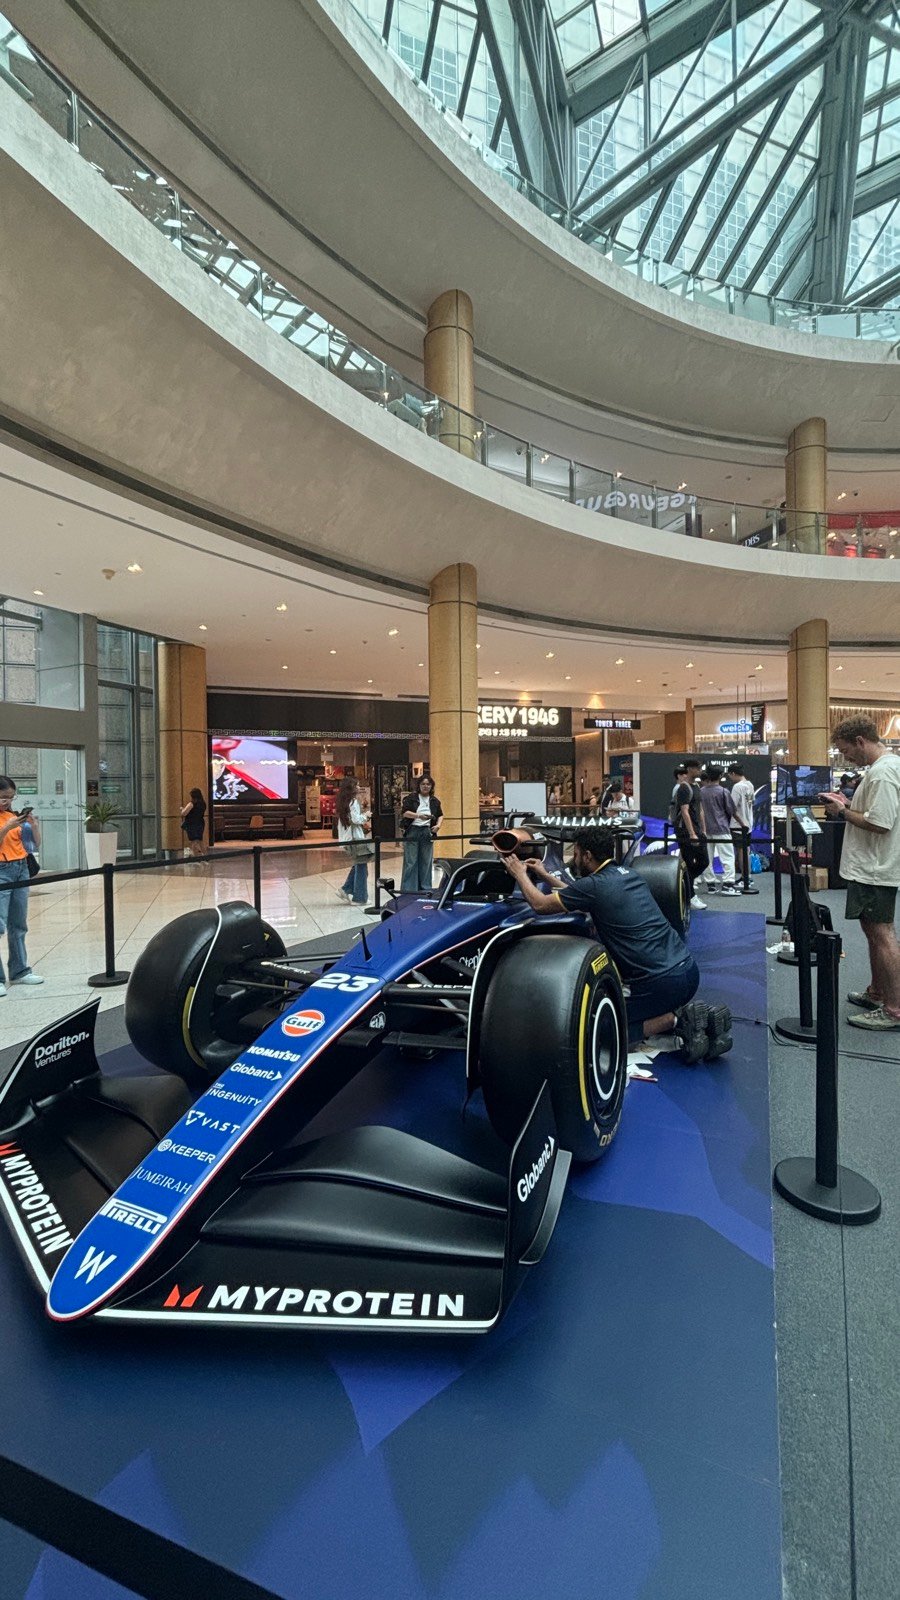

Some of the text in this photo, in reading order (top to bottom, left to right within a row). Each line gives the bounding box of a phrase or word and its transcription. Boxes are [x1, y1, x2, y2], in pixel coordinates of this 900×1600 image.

[744, 534, 760, 547] DBS
[519, 707, 560, 726] 1946
[595, 720, 632, 729] TOWER THREE
[541, 816, 623, 827] WILLIAMS
[310, 972, 380, 993] 23
[285, 1016, 321, 1030] Gulf
[34, 1048, 72, 1069] Ventures
[247, 1045, 301, 1063] KOMATSU
[230, 1063, 275, 1080] Globant
[205, 1087, 262, 1107] INGENUITY
[201, 1118, 241, 1134] VAST
[169, 1144, 216, 1164] KEEPER
[130, 1166, 193, 1195] JUMEIRAH
[517, 1141, 551, 1202] Globant
[1, 1153, 75, 1255] MYPROTEIN
[99, 1197, 168, 1235] PIRELLI
[73, 1245, 117, 1285] W
[206, 1284, 464, 1317] MYPROTEIN
